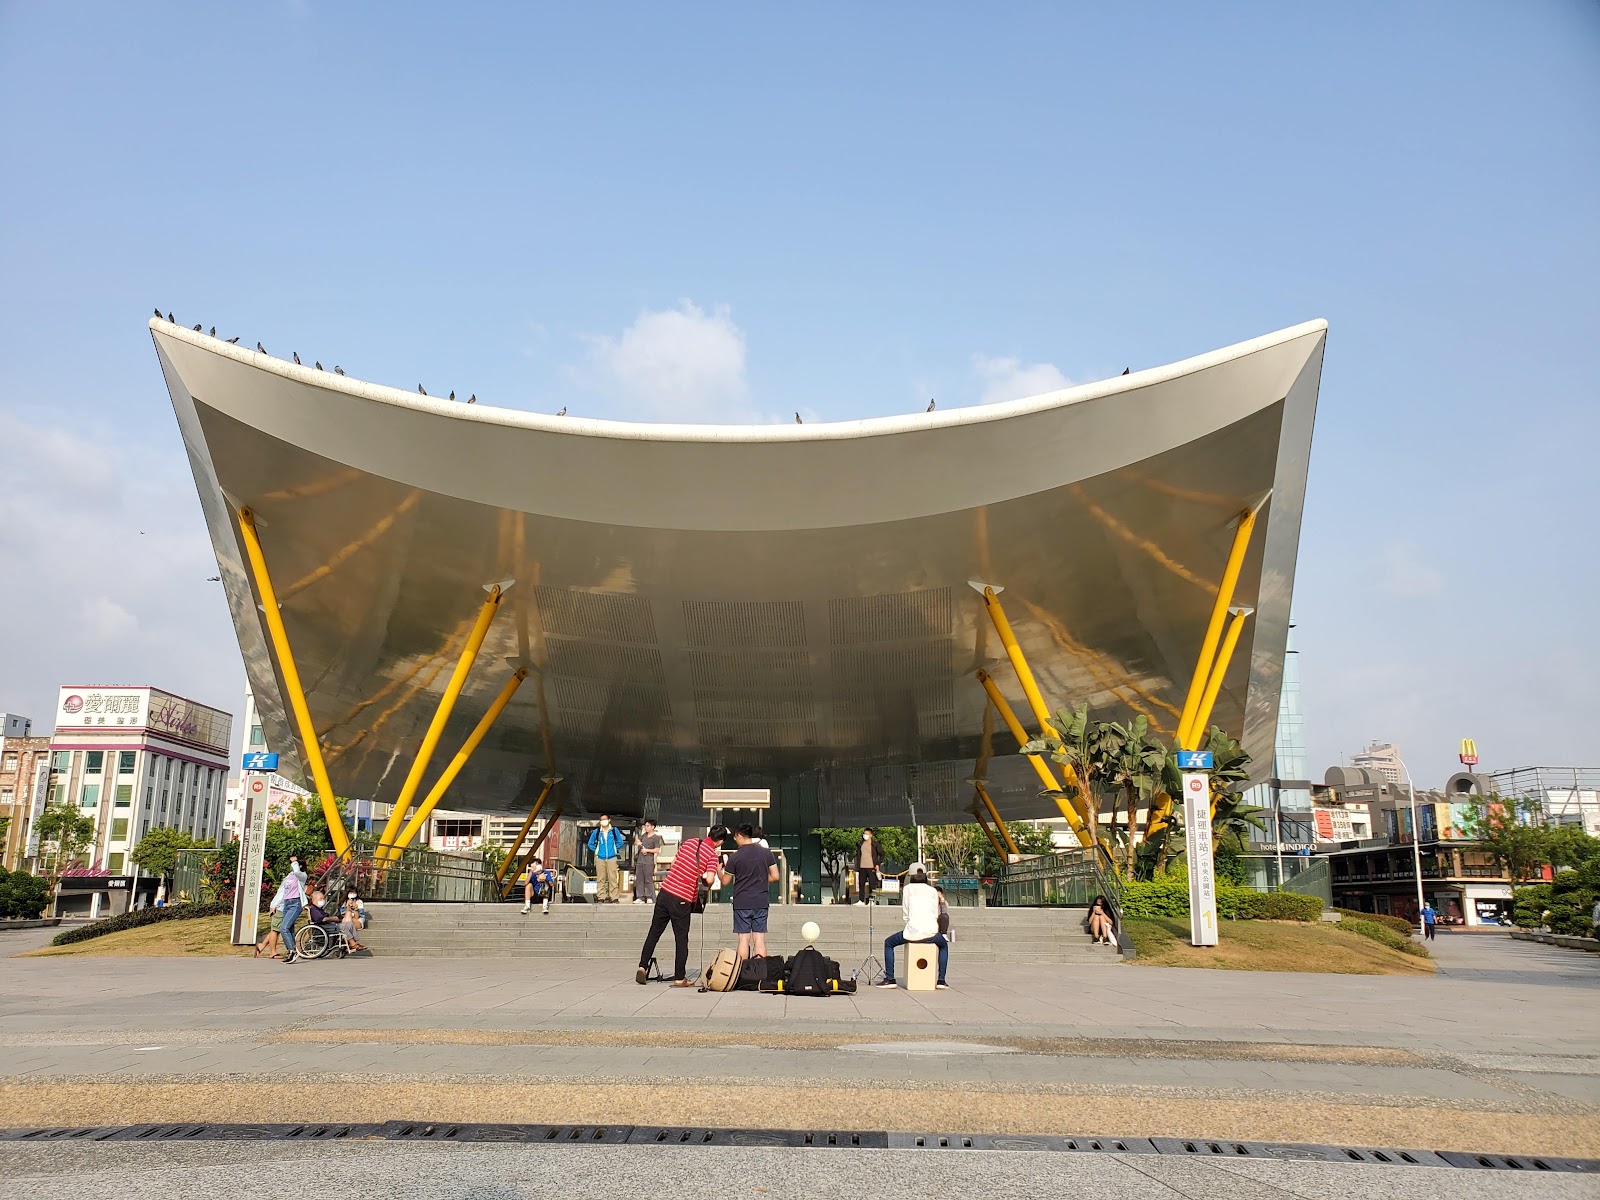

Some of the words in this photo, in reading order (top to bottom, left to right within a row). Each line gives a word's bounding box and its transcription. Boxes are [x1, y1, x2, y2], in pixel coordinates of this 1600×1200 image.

[84, 693, 140, 713] 愛爾麗
[1260, 843, 1279, 851] hote
[1285, 843, 1317, 851] INDIGO
[245, 913, 253, 928] 1
[1203, 910, 1212, 928] 1
